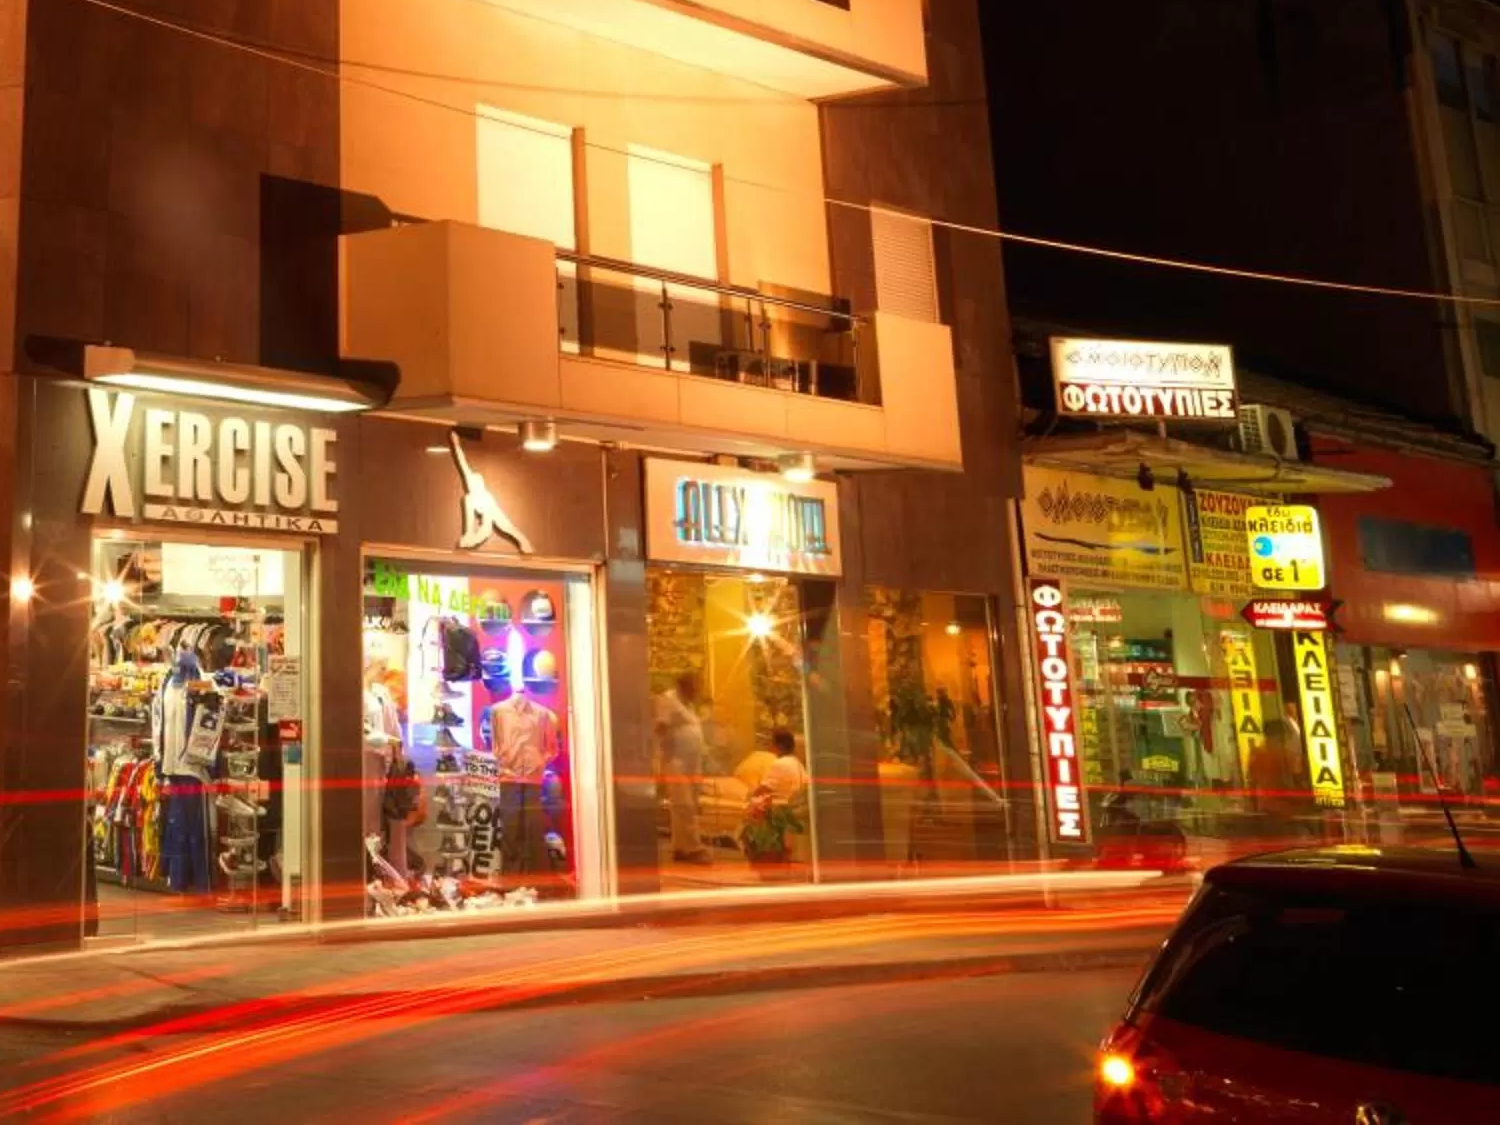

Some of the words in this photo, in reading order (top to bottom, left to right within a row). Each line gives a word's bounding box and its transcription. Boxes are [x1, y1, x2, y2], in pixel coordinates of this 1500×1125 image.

[1062, 384, 1235, 417] ΦΩΤΟΤΥΠΙΕΣ
[81, 387, 339, 518] XERCISE
[162, 507, 325, 533] ΑΘΛΗΤΙΚΑ
[1032, 584, 1082, 838] ΦΩΤΟΤΥΠΙΕΣ
